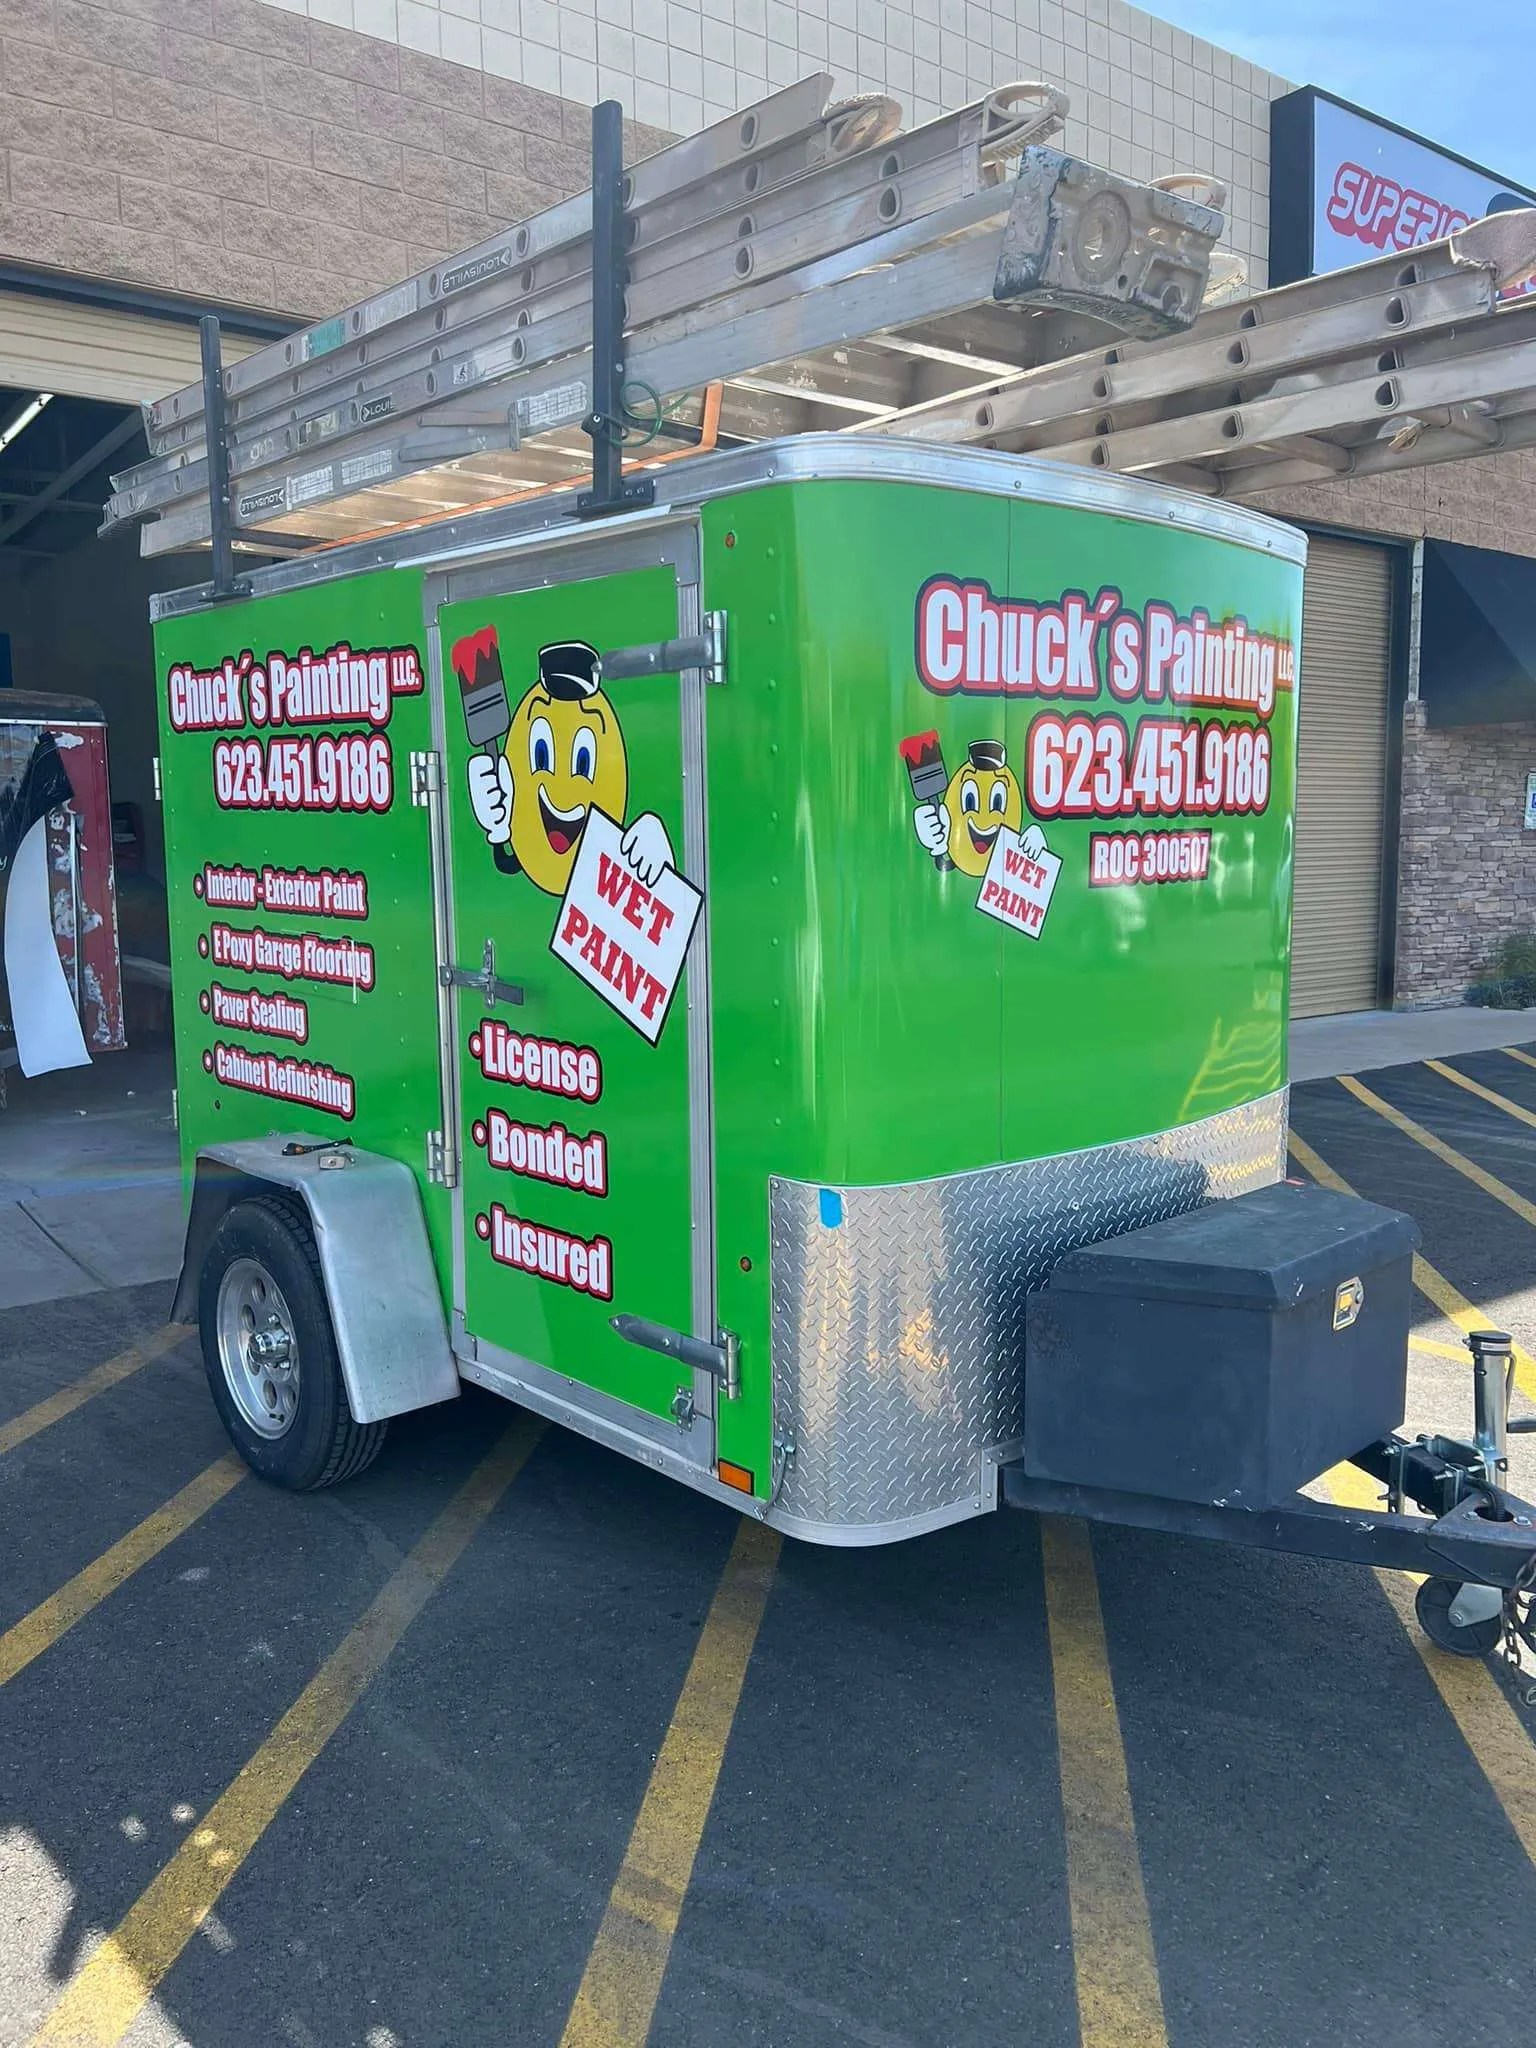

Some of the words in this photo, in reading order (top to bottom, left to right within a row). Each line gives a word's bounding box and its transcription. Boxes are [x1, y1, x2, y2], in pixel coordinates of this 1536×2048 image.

[1327, 162, 1476, 250] SUPERI
[442, 255, 501, 290] LOUISVILLE
[268, 650, 388, 721] Painting
[391, 653, 420, 688] LLC.
[1146, 610, 1275, 711] Painting
[213, 738, 391, 805] 623.451.9186
[1032, 720, 1270, 810] 623.451.9186
[206, 869, 256, 904] Interior
[264, 871, 321, 909] Exterior
[322, 876, 366, 913] Paint
[1004, 848, 1048, 890] WET
[1093, 838, 1140, 880] ROC
[1142, 835, 1209, 877] 300507
[596, 852, 675, 946] WET
[982, 879, 1044, 928] PAINT
[303, 938, 372, 985] Flooring
[561, 903, 668, 1021] PAINT
[213, 987, 249, 1024] Paver
[250, 994, 306, 1038] Sealing
[215, 1047, 267, 1089] Cabinet
[268, 1058, 353, 1114] Refinishing
[483, 1023, 600, 1098] License
[489, 1113, 605, 1191] Bonded
[492, 1208, 609, 1295] Insured
